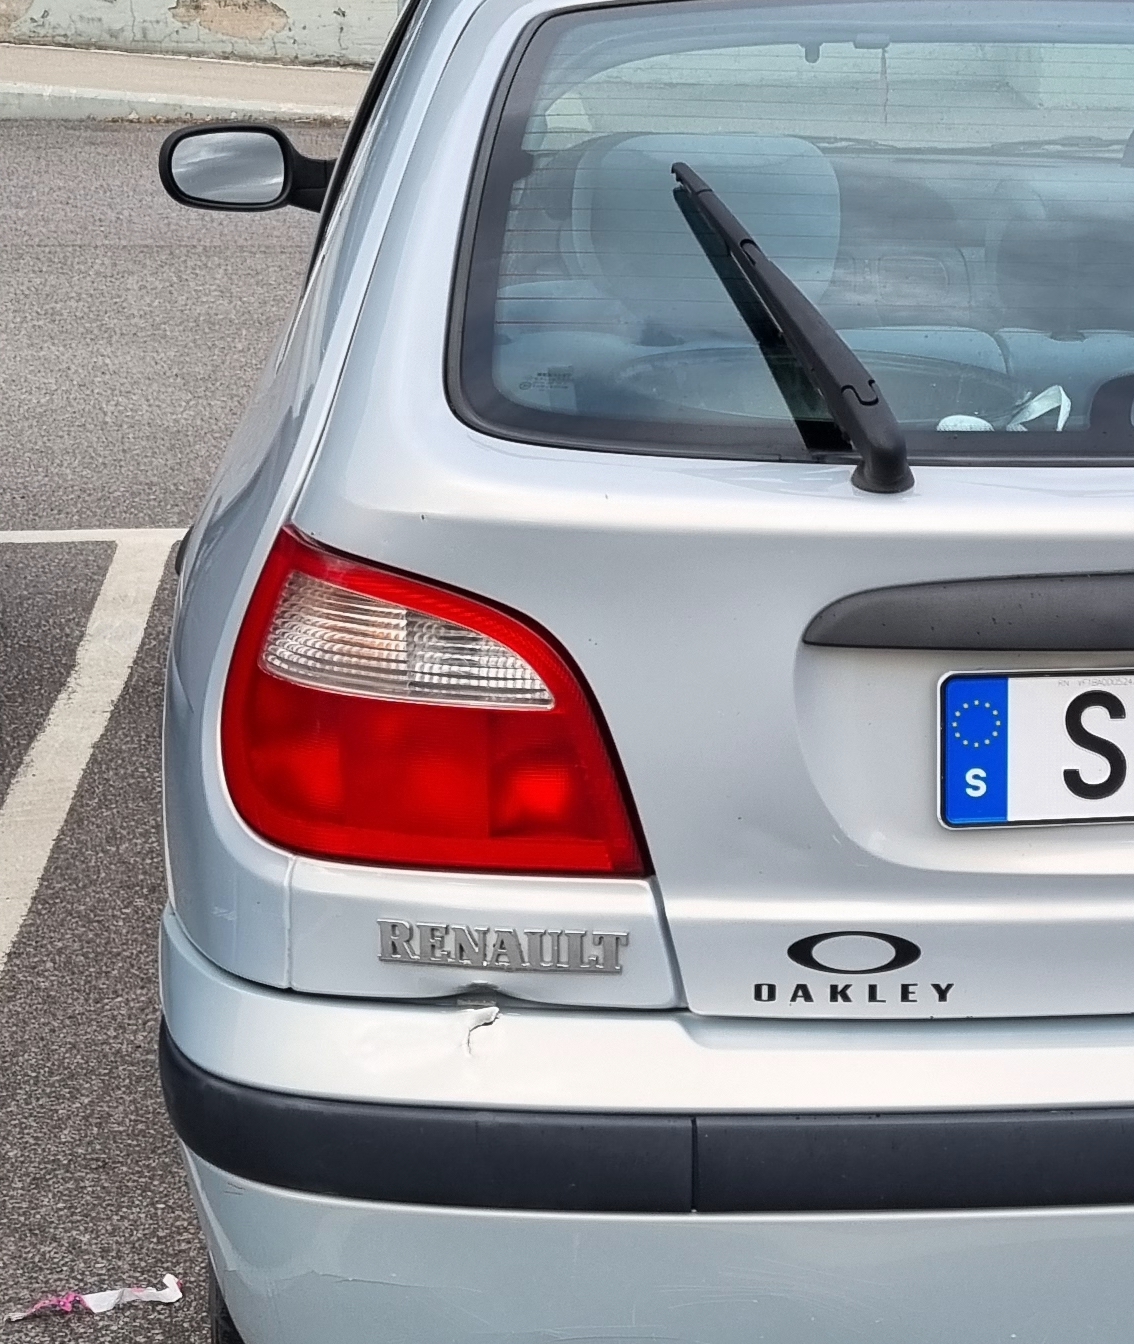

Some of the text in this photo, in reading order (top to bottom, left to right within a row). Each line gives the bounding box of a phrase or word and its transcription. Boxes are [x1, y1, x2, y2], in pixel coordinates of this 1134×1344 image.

[965, 768, 987, 798] S
[376, 917, 630, 974] RENAULT
[753, 983, 956, 1004] OAKLEY
